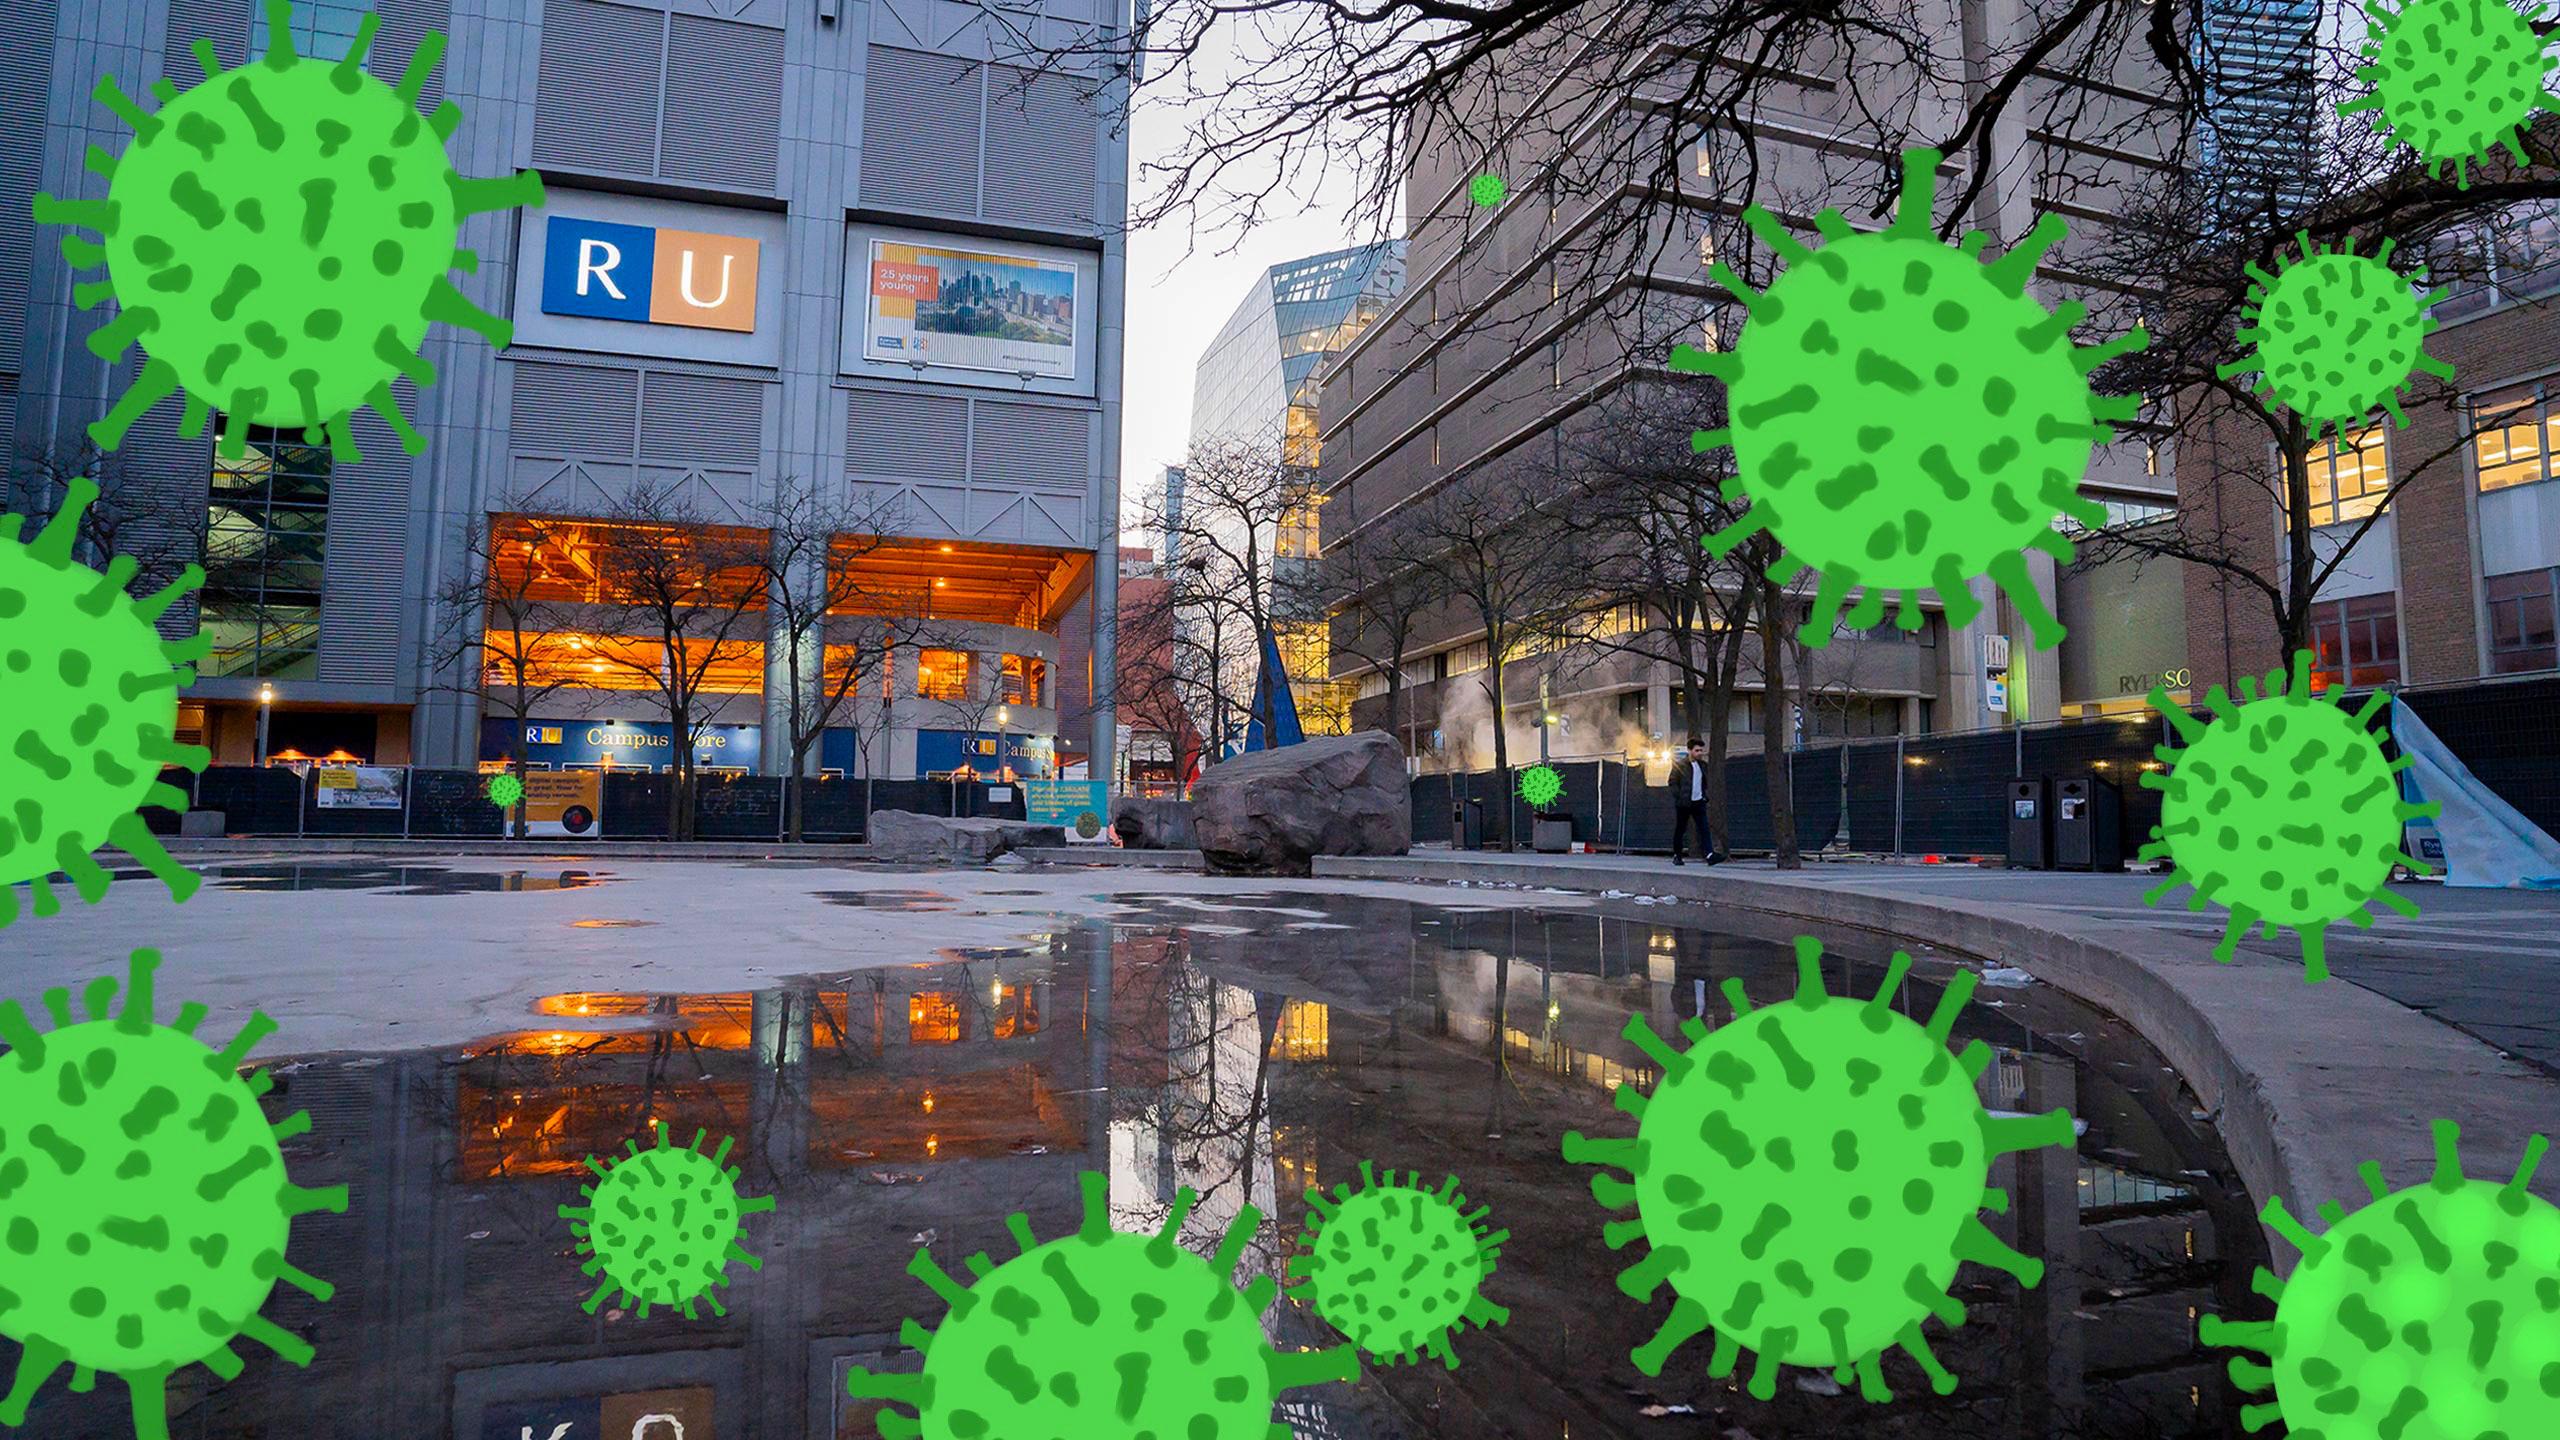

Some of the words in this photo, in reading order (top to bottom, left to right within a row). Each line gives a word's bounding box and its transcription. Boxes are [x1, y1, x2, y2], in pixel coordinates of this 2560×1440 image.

[880, 269, 896, 279] 25
[898, 272, 929, 284] years
[880, 281, 915, 294] young
[587, 728, 669, 749] Campus
